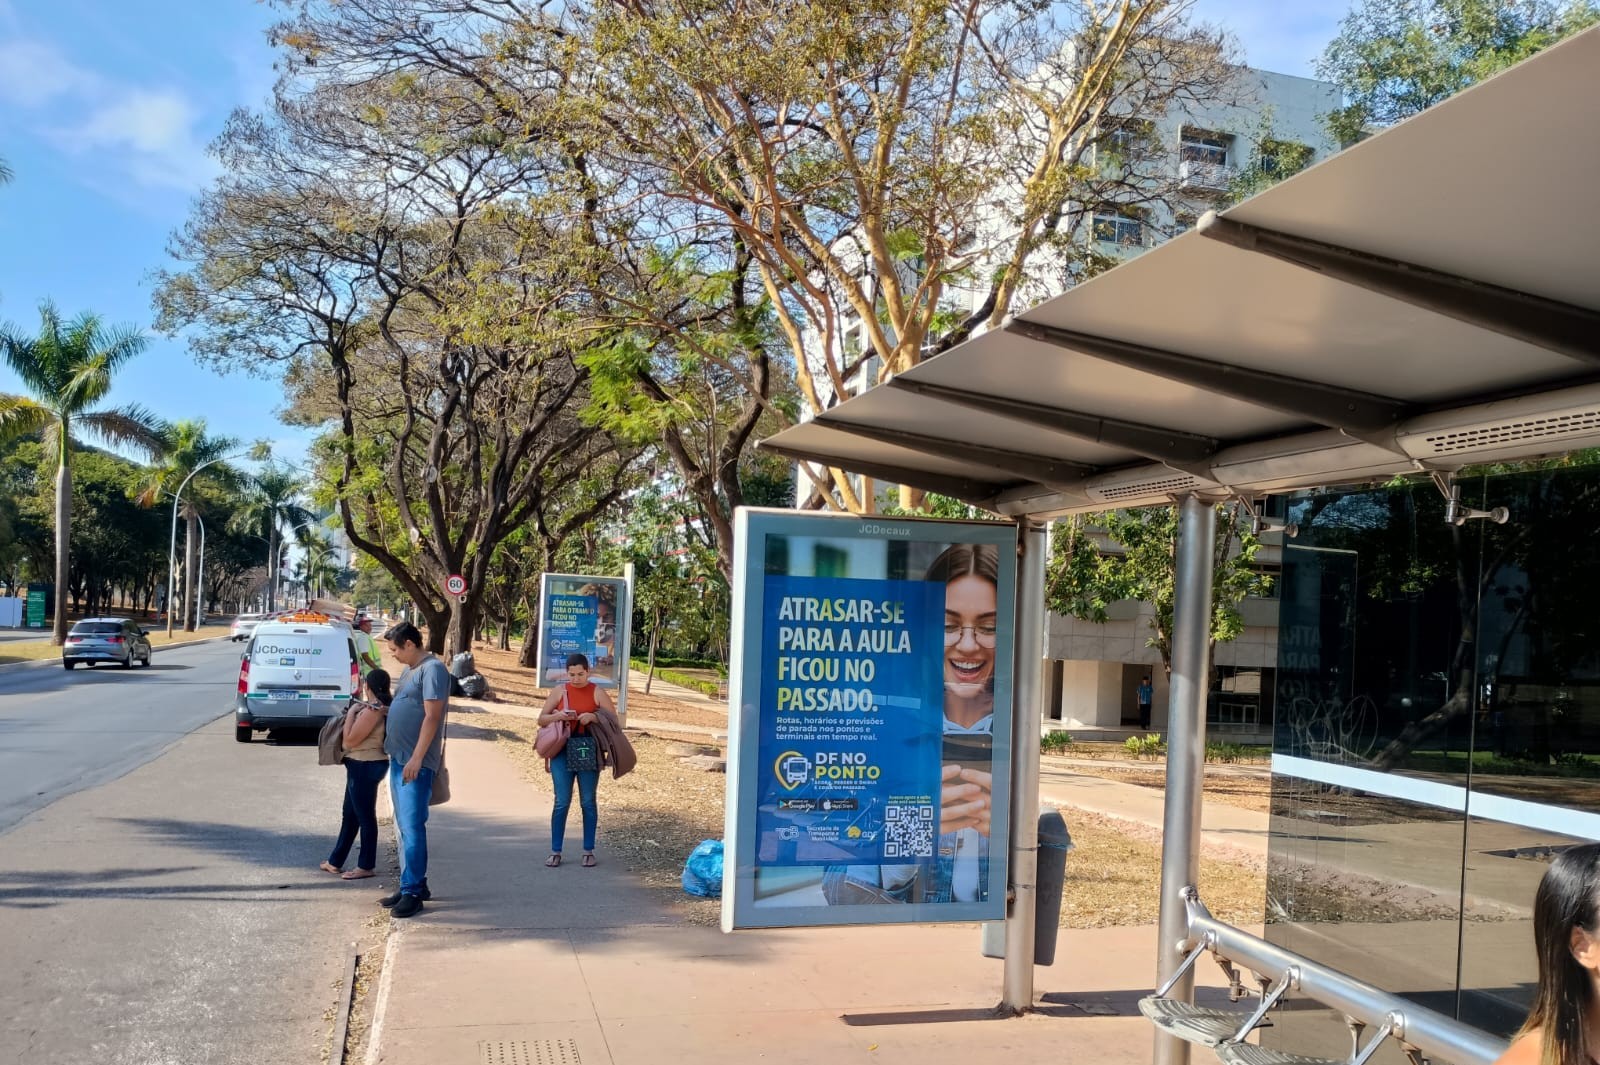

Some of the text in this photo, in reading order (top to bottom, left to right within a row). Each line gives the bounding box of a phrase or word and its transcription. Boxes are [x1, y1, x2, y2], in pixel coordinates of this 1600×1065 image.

[858, 524, 911, 536] JCDecaux
[450, 580, 462, 588] 60
[779, 597, 905, 624] ATRASAR-SE
[779, 627, 911, 653] PARA A AULA
[255, 645, 311, 655] JCDecaux
[778, 656, 876, 682] FICOU NO
[777, 687, 878, 713] PASSADO.
[776, 717, 802, 726] Rotas,
[804, 716, 838, 725] horários
[846, 717, 884, 726] previsões
[788, 725, 817, 733] parada
[835, 726, 864, 734] pontos
[831, 734, 859, 742] tempo
[860, 733, 878, 741] real.
[815, 752, 867, 765] DF NO
[815, 765, 881, 779] PONTO
